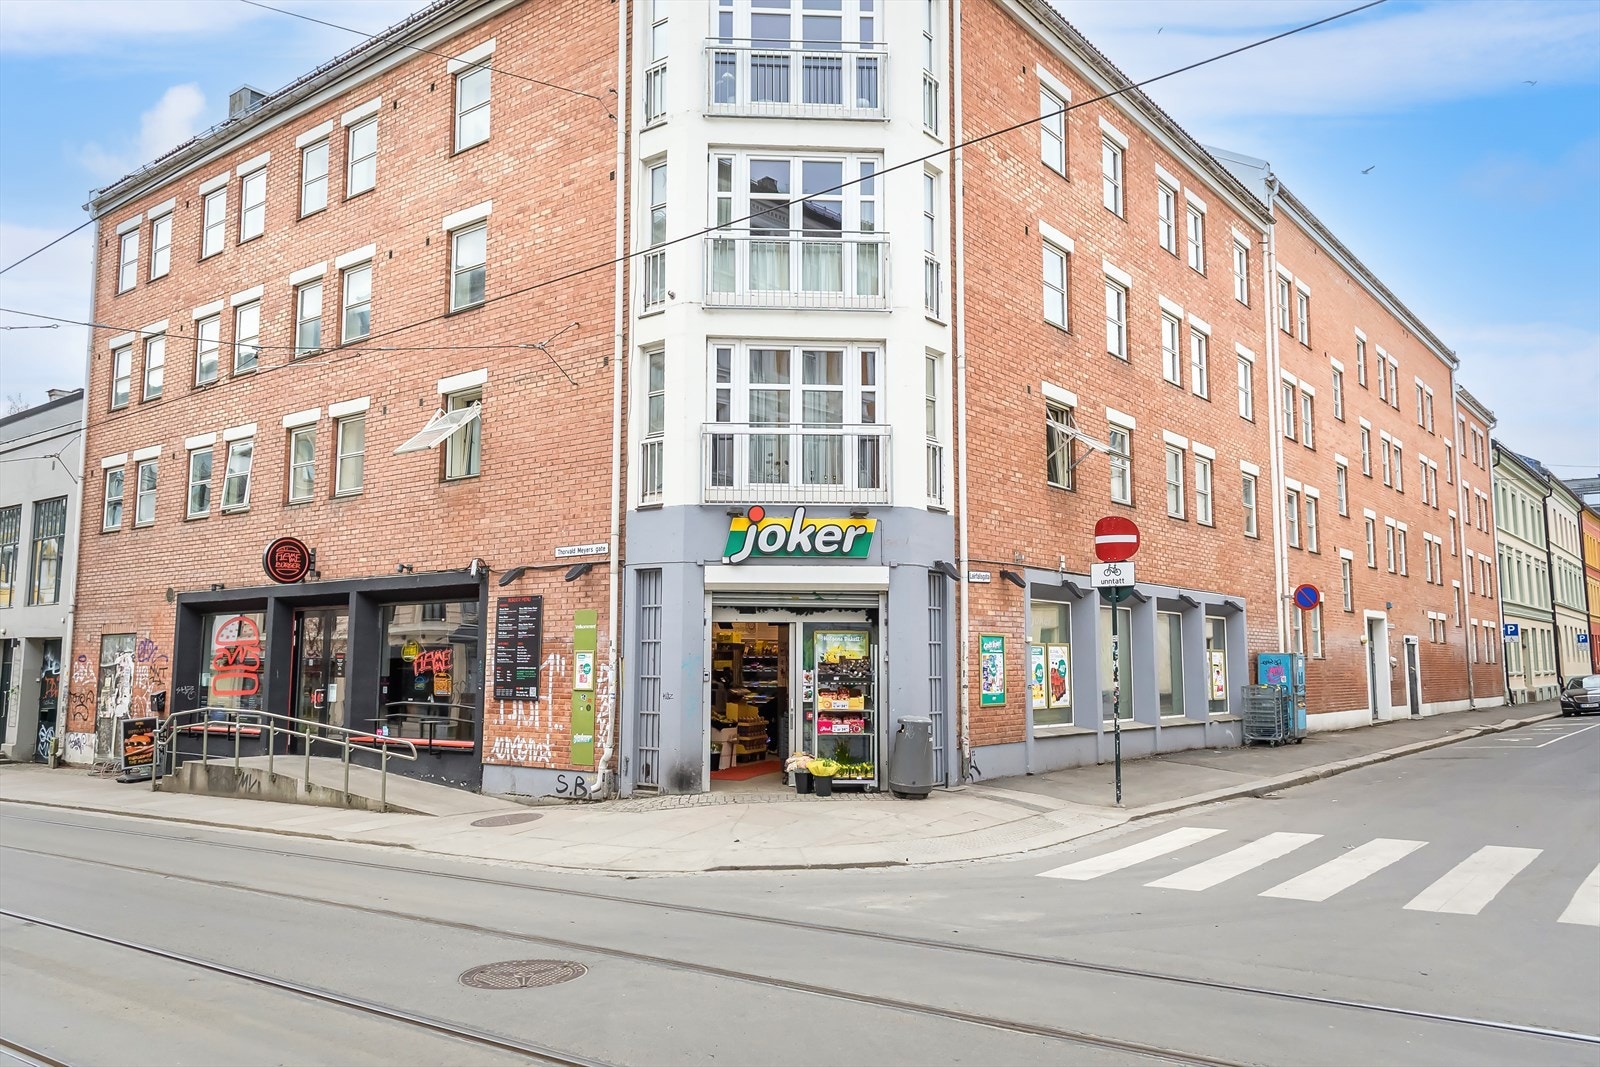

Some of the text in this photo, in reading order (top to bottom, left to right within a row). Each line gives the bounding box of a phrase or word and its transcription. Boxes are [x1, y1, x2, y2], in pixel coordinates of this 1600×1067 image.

[729, 505, 868, 565] joker
[557, 545, 606, 556] Thorvald Meyers gate
[1507, 625, 1516, 635] P
